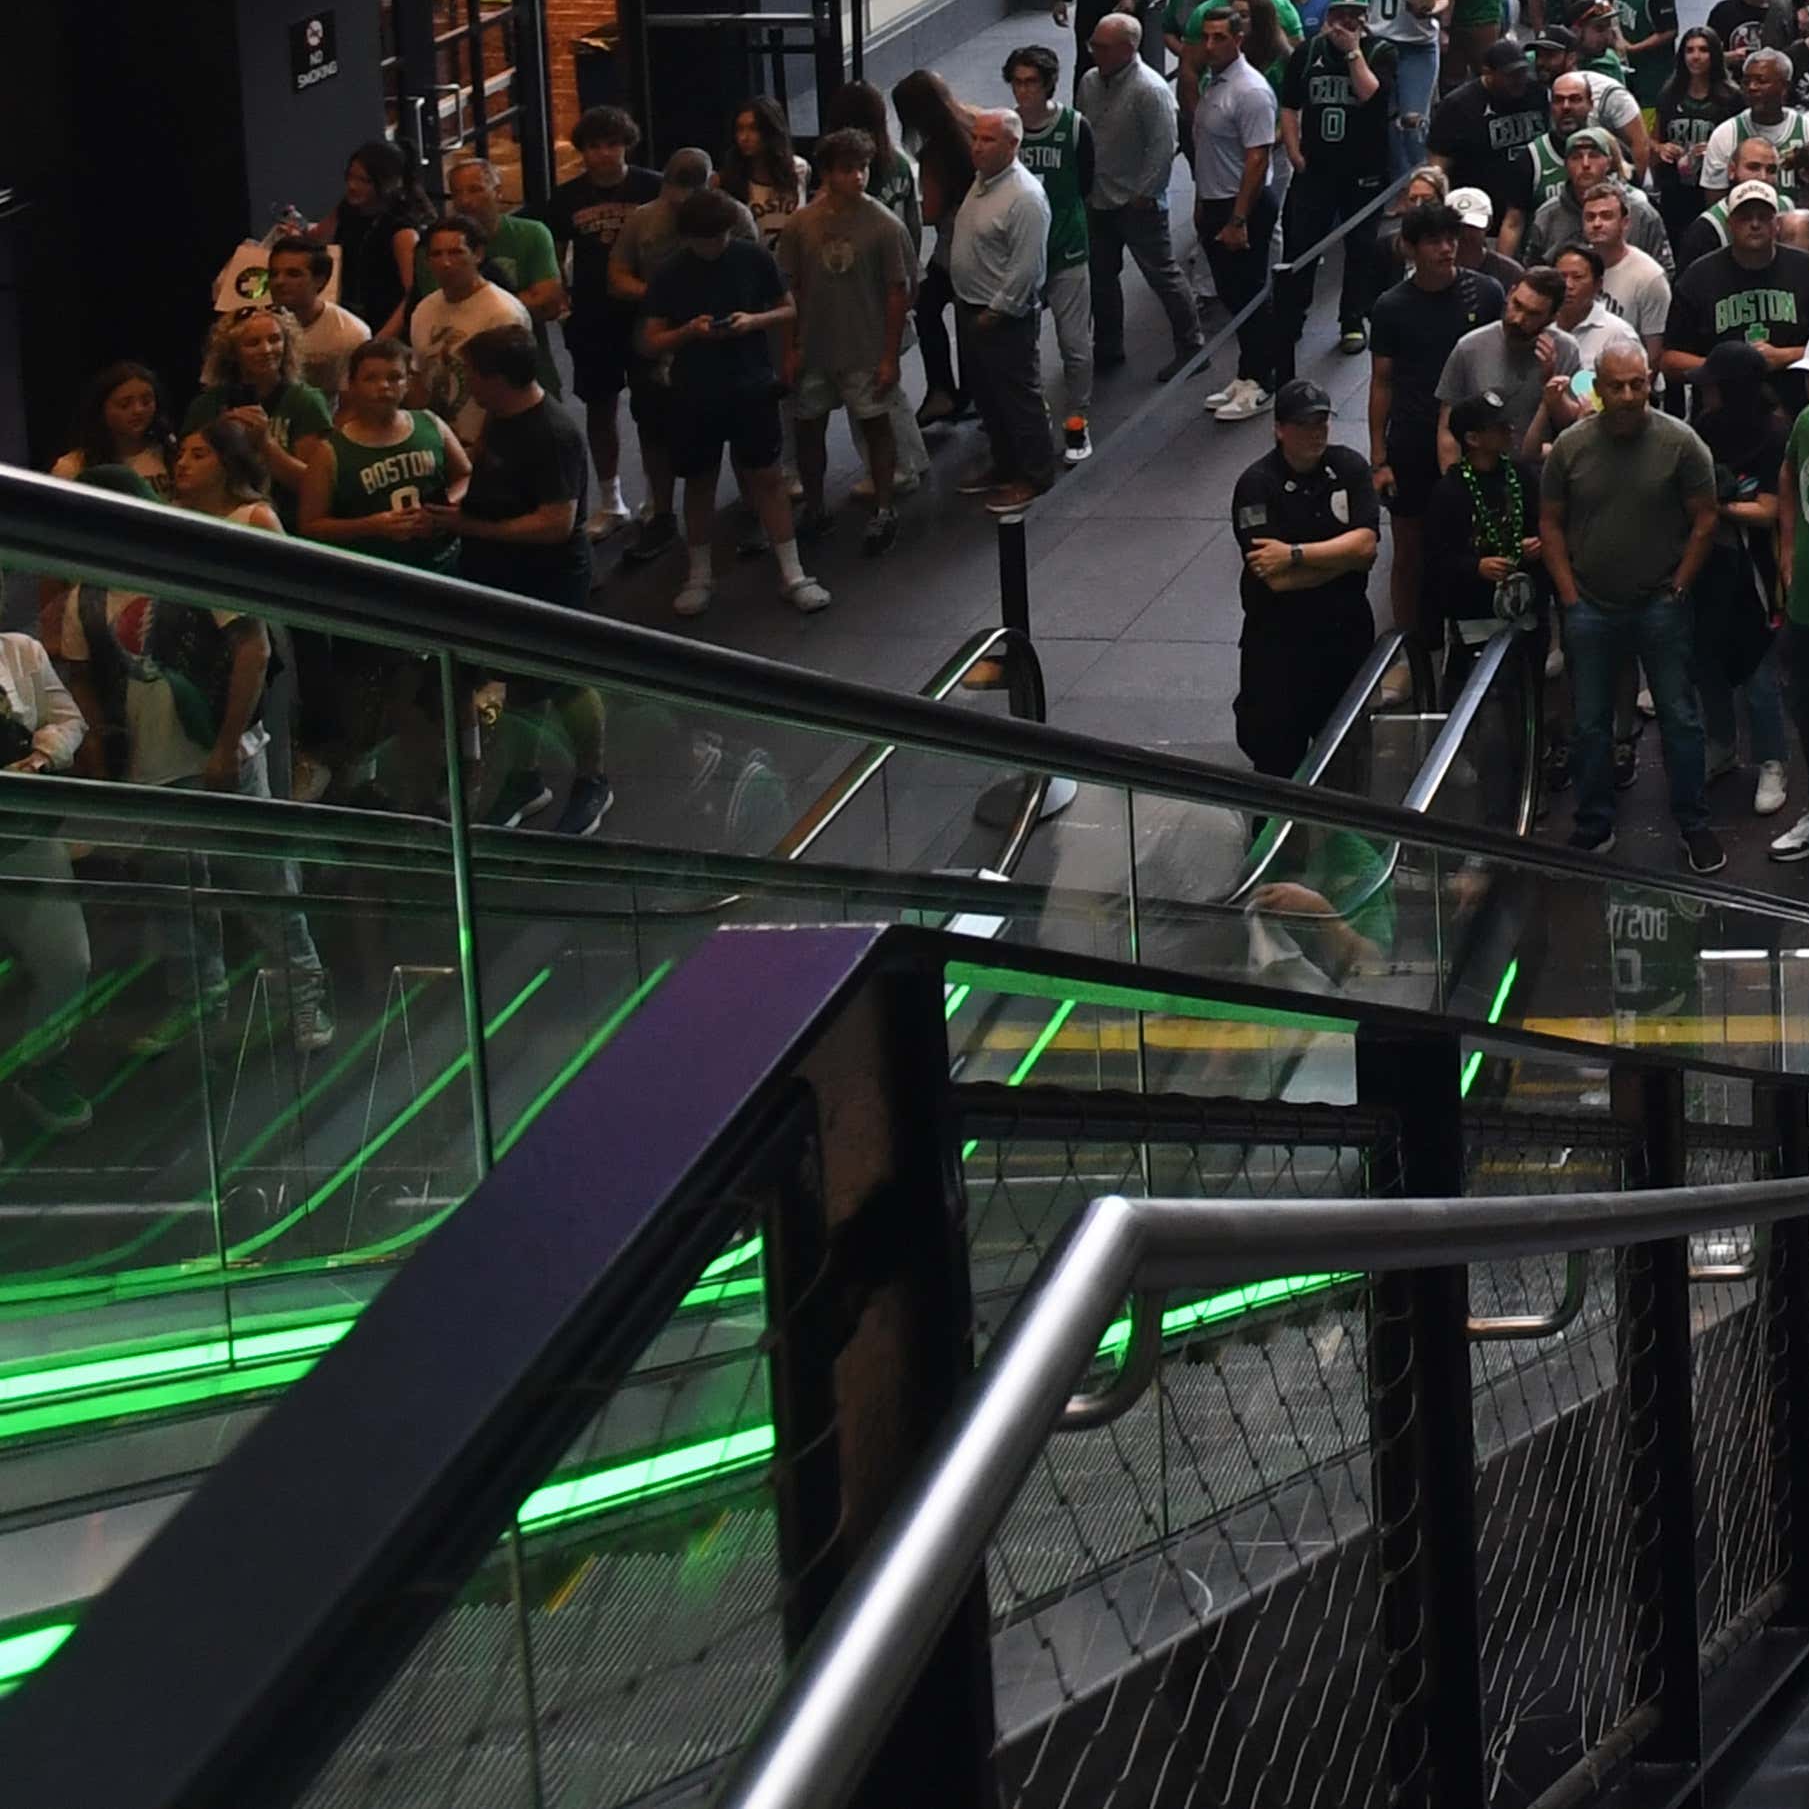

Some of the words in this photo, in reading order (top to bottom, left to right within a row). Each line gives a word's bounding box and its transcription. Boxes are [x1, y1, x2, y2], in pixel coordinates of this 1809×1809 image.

[297, 60, 339, 89] SMOKING
[1322, 108, 1346, 141] 0
[1715, 292, 1798, 334] BOSTON
[360, 450, 437, 495] BOSTON
